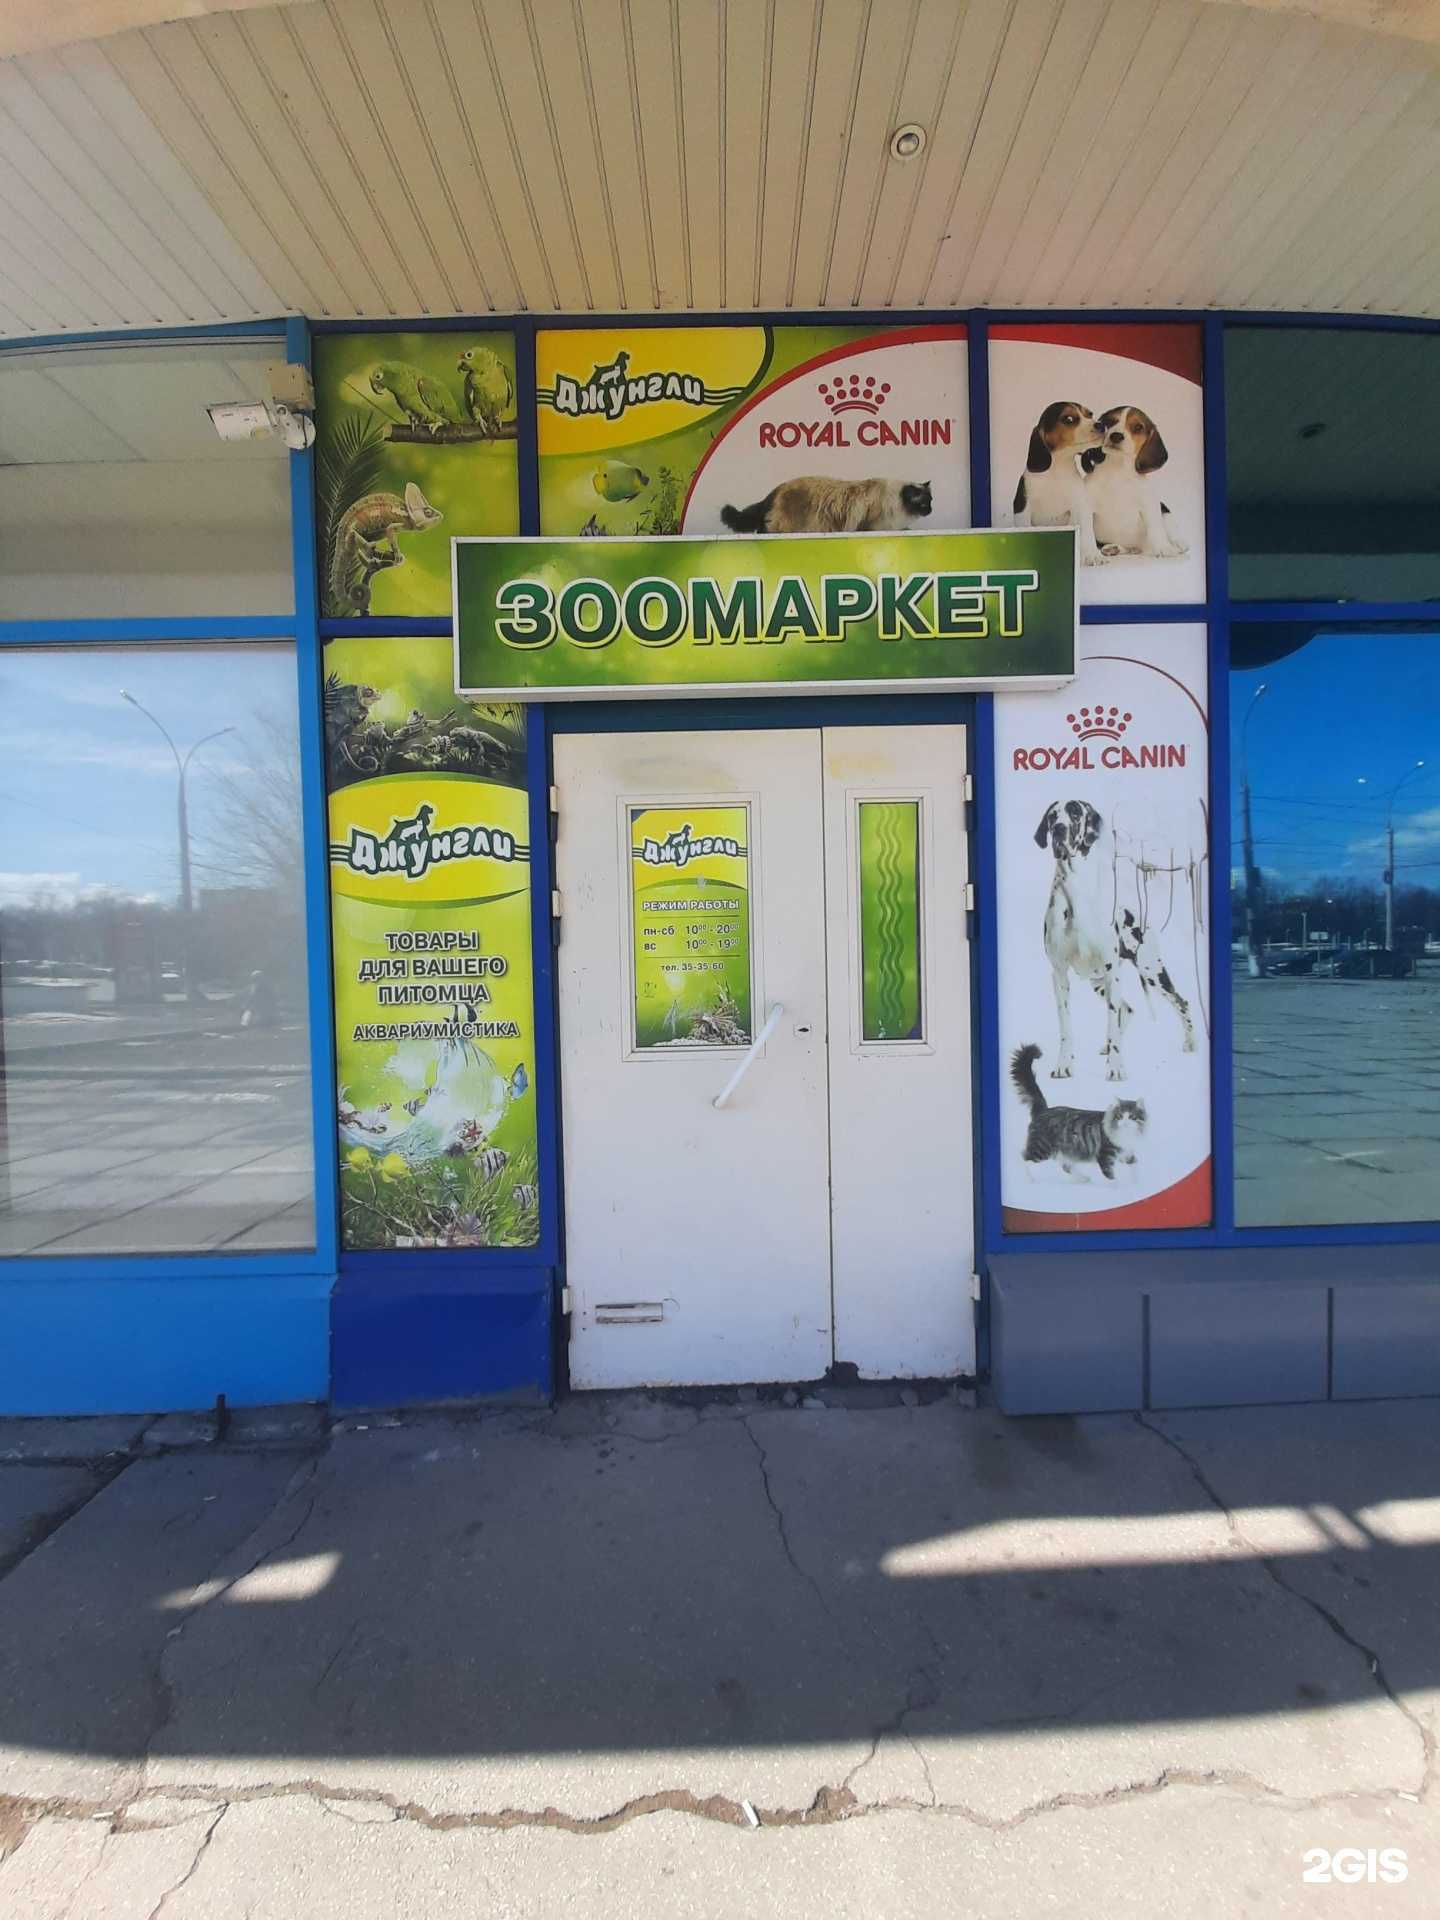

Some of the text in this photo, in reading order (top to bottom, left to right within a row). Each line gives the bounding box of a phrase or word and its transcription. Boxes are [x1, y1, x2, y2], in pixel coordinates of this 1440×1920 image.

[553, 373, 704, 419] Джунгли
[759, 419, 951, 448] ROYAL CANIN
[495, 570, 1038, 649] ЗООМАРКЕТ
[1013, 744, 1186, 770] ROYAL CANIN
[349, 828, 515, 877] Джунгли
[643, 837, 739, 867] Джунгли
[643, 899, 739, 911] РЕЖИМ РАБОТЫ
[386, 931, 479, 950] ТОВАРЫ
[643, 925, 675, 936] пн-сб
[359, 956, 506, 981] ДЛЯ ВАШЕГО
[378, 983, 489, 1005] ПИТОМЦА
[354, 1021, 518, 1041] АКВАРИУМИСТИКА
